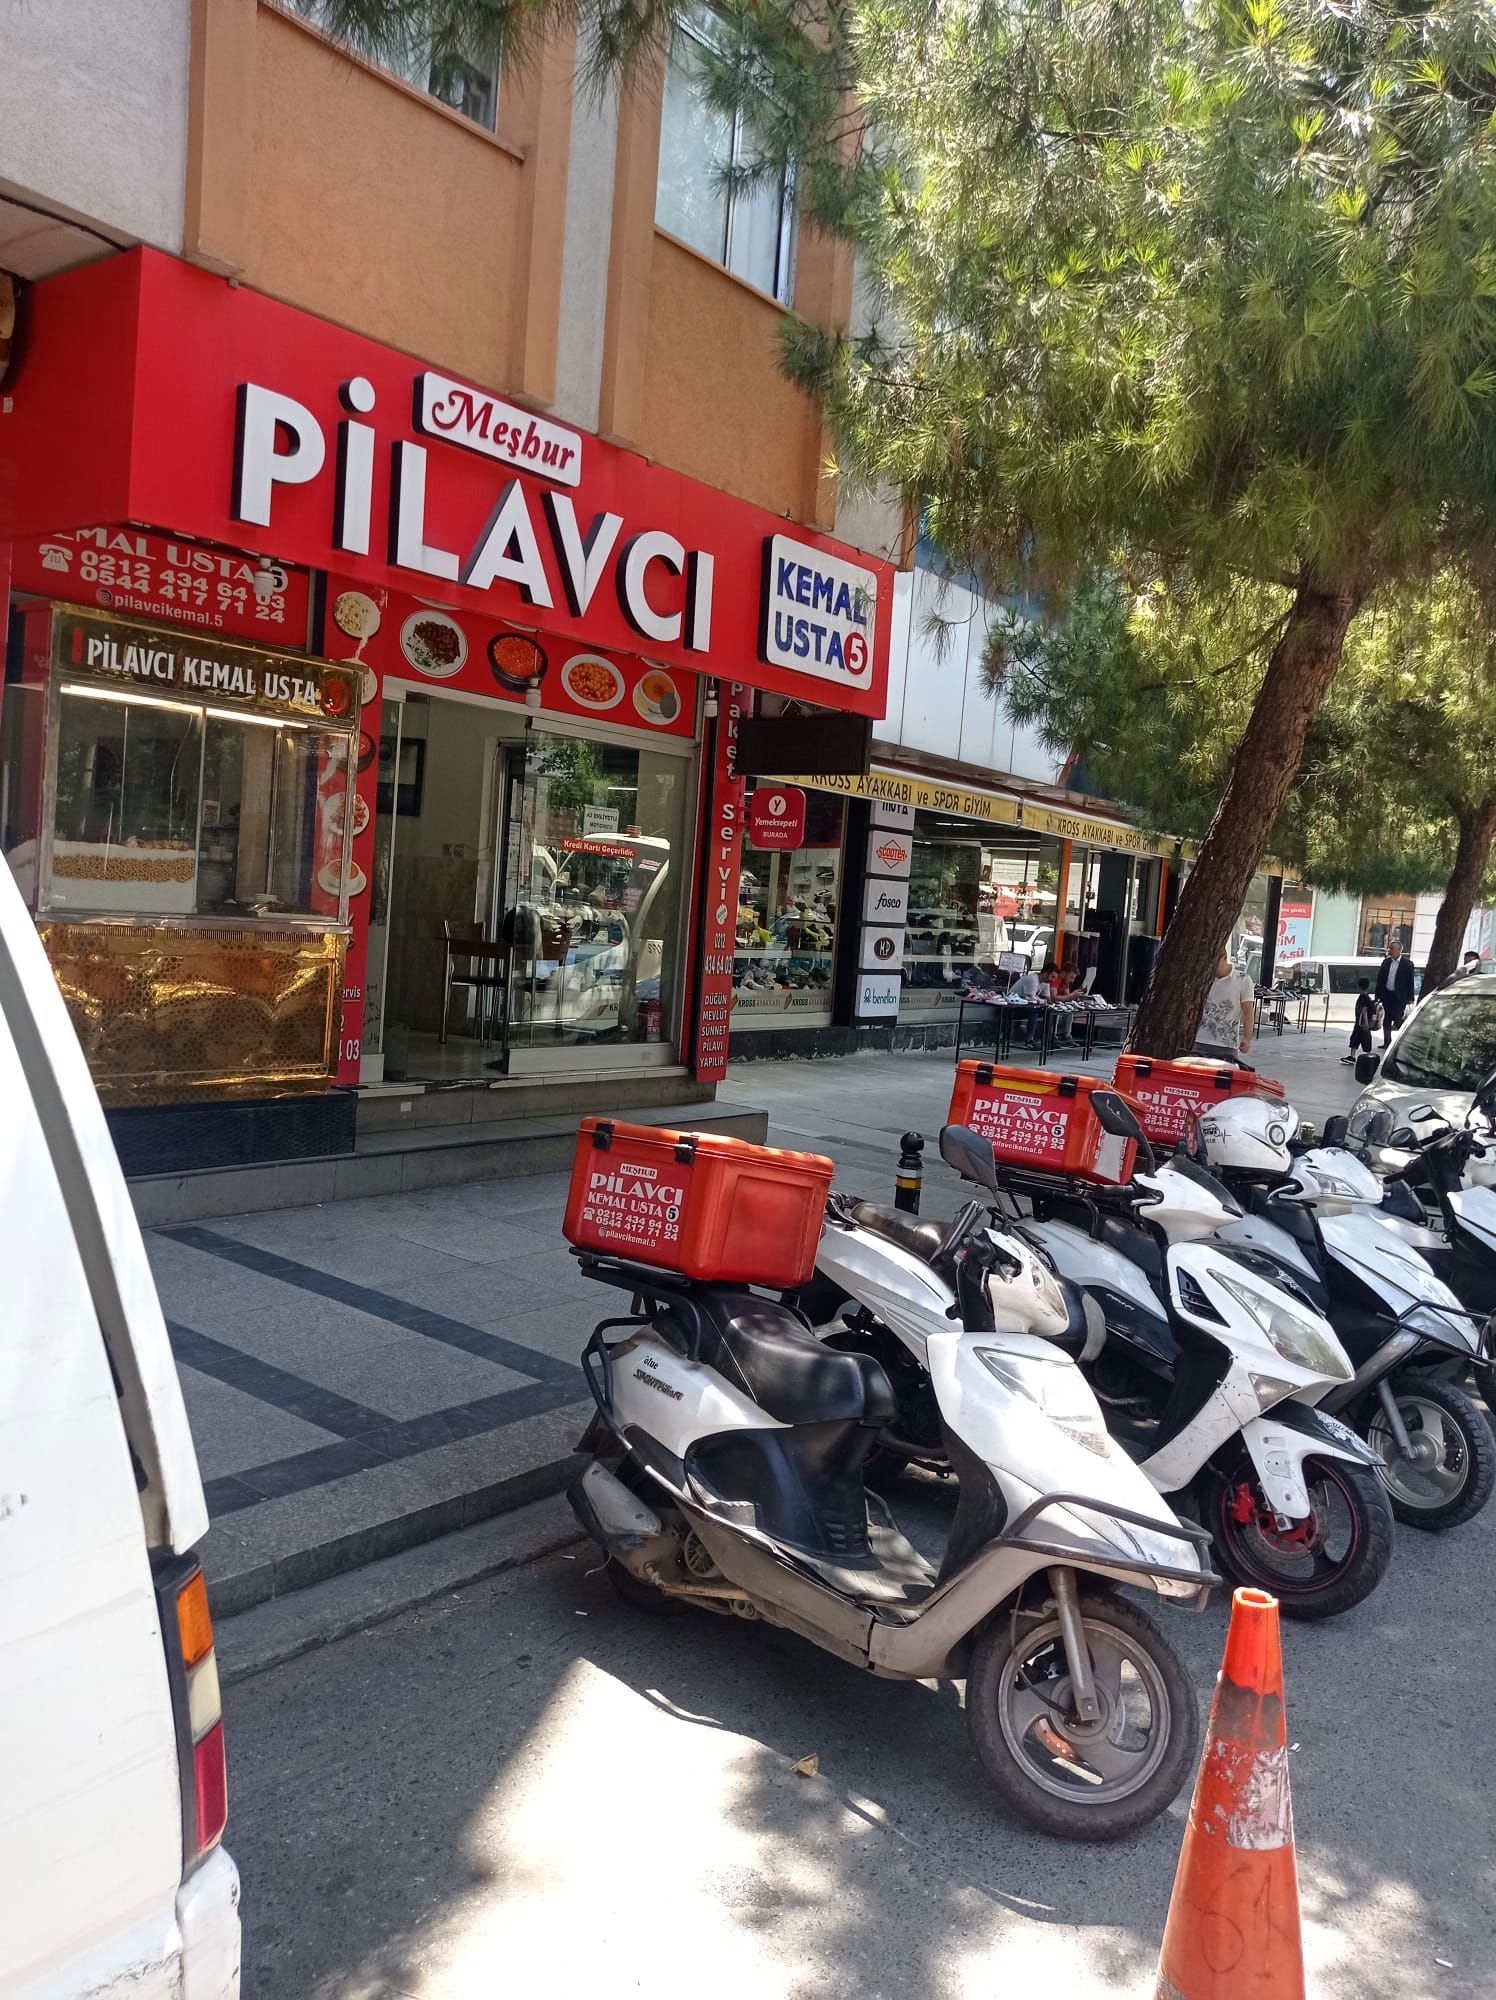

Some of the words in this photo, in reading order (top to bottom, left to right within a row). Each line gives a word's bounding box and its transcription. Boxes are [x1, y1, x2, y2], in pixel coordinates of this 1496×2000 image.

[431, 389, 575, 471] Meşhur
[80, 549, 151, 579] 0212
[159, 569, 209, 592] 434
[217, 582, 248, 600] 64
[166, 544, 256, 585] USTA
[79, 565, 151, 594] 0544
[158, 585, 208, 606] 417
[217, 596, 245, 615] 71
[255, 605, 285, 624] 24
[776, 556, 868, 626] KEMAL
[114, 592, 224, 627] pilavcikemal.5
[774, 610, 846, 671] USTA
[847, 636, 866, 671] 5
[183, 656, 256, 695] KEMAL
[263, 672, 317, 706] USTA
[856, 776, 912, 802] AYAKKABI
[917, 790, 929, 805] ve
[932, 790, 959, 812] SPOR
[963, 794, 992, 817] GİYİM
[754, 816, 798, 829] Yemeksepeti
[1057, 817, 1080, 836] KROSS
[1081, 823, 1114, 844] AYAKKABI
[563, 839, 582, 850] Kredi
[762, 831, 788, 839] BURADA
[878, 846, 906, 861] SCOOTER
[874, 892, 901, 910] fosco
[704, 992, 727, 1005] DÜĞÜN
[702, 1009, 727, 1021] MEVLÜT
[701, 1024, 726, 1037] SÜNNET
[346, 1039, 360, 1061] 03
[702, 1038, 723, 1052] PİLAVI
[700, 1056, 724, 1068] YAPILIR
[972, 1112, 1012, 1127] KEMAL
[1016, 1119, 1048, 1133] USTA
[621, 1164, 656, 1178] MEŞHUR
[588, 1191, 628, 1210] KEMAL
[631, 1200, 663, 1217] USTA
[596, 1216, 621, 1228] 0544
[624, 1222, 644, 1233] 417
[647, 1227, 660, 1237] 71
[663, 1231, 678, 1241] 24
[597, 1209, 623, 1220] 0212
[626, 1214, 646, 1225] 434
[648, 1219, 662, 1229] 64
[665, 1223, 679, 1233] 03
